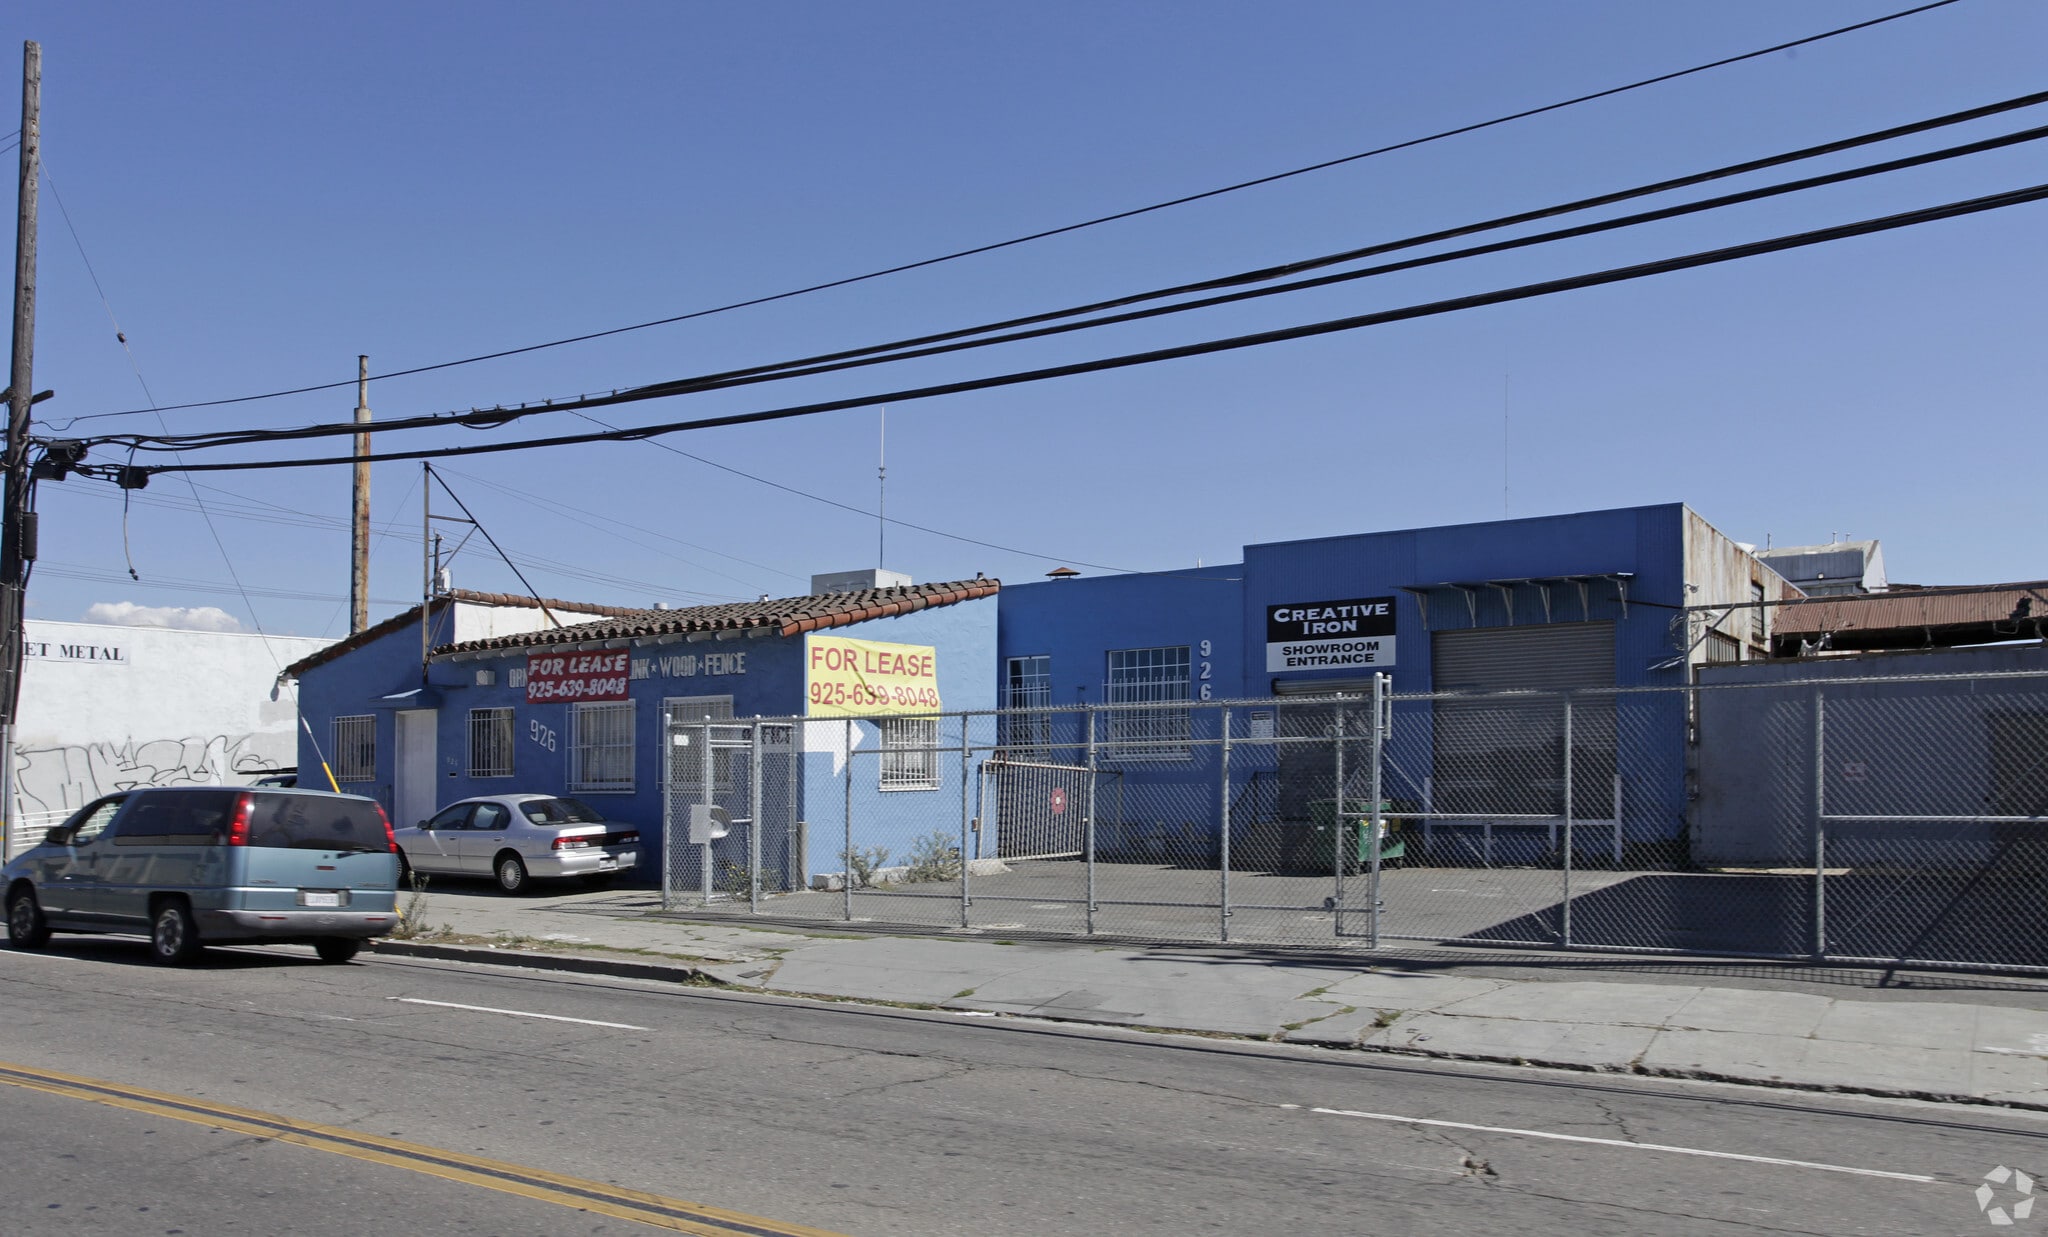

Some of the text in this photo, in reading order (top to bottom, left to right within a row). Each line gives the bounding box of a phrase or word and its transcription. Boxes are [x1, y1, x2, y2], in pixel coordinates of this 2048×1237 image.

[1303, 620, 1357, 634] IRON
[60, 644, 124, 661] METAL
[1282, 641, 1380, 656] SHOWROOM
[528, 654, 627, 676] FOR LEASE
[659, 655, 697, 678] WOOD
[704, 652, 746, 676] FENCE
[811, 646, 933, 677] FOR LEASE
[1200, 639, 1212, 701] 926
[1286, 653, 1375, 667] ENTRANCE
[528, 677, 627, 699] 925-639-8048
[810, 681, 938, 708] 925-639-8048
[530, 719, 556, 752] 926
